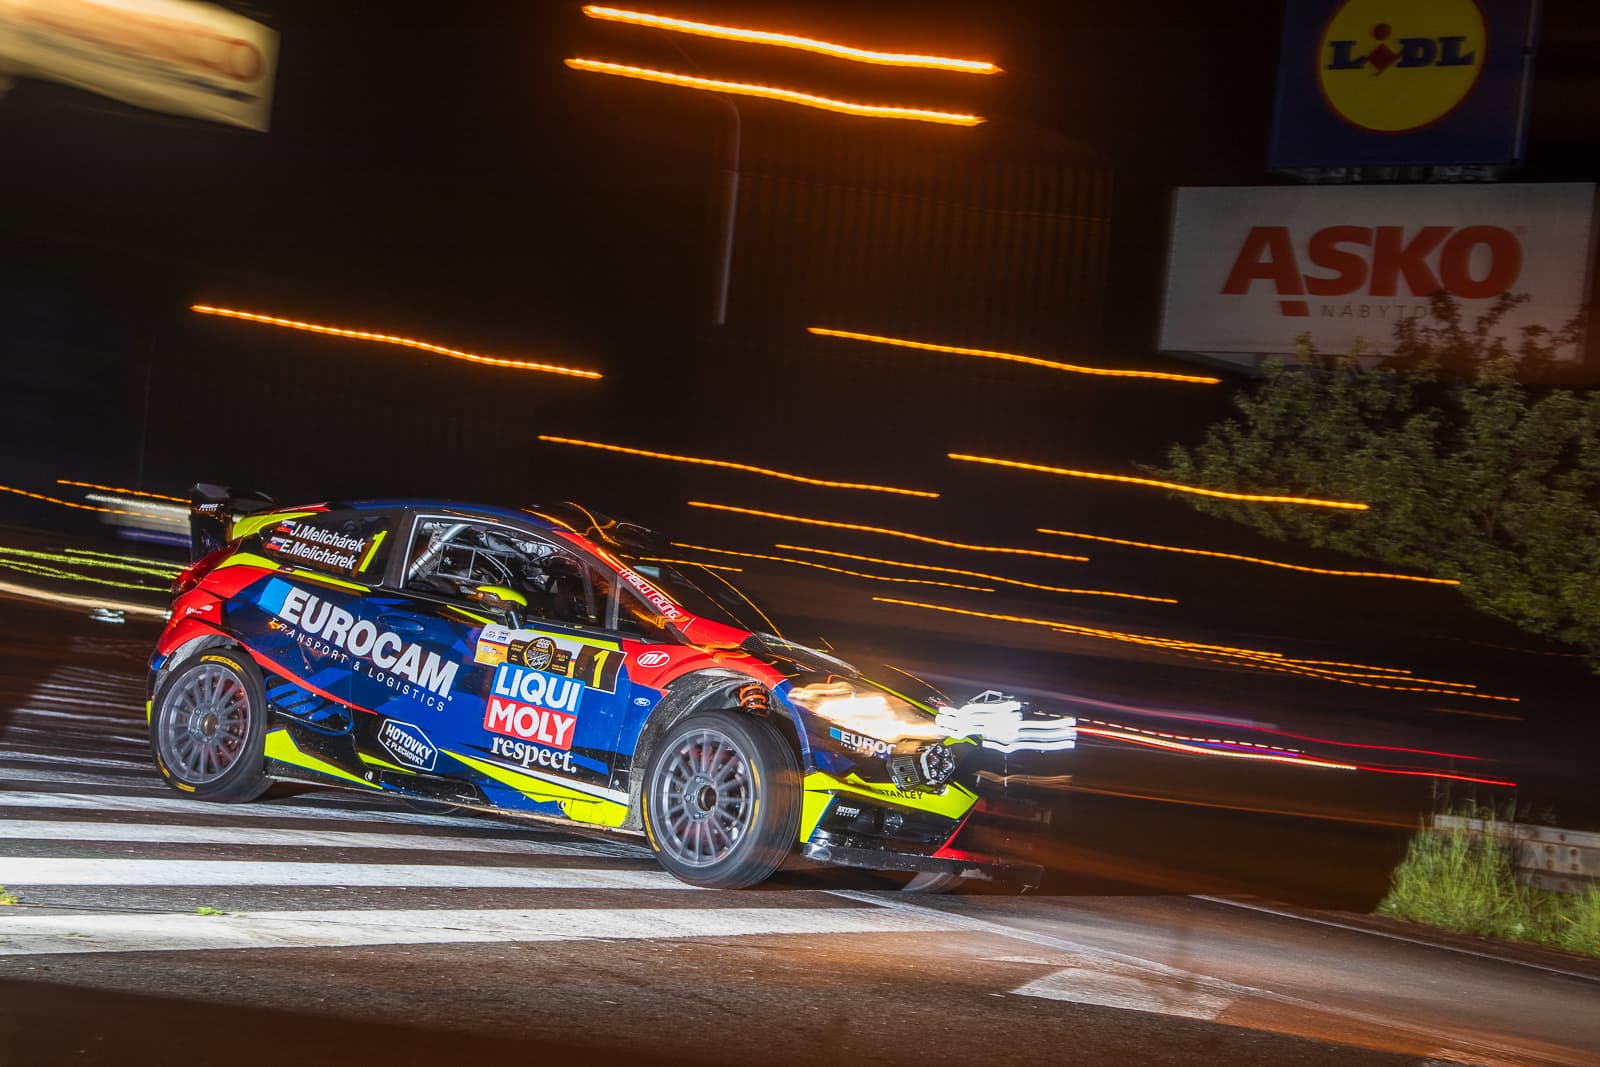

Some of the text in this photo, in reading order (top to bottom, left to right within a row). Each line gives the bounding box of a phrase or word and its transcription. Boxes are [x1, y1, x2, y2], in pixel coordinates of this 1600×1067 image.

[1220, 225, 1523, 300] ASKO
[279, 540, 358, 570] E.Melichárek
[290, 523, 366, 553] J.Melichárek
[358, 530, 388, 573] 1
[270, 617, 347, 664] TRANSPORT
[353, 661, 360, 671] &
[368, 669, 445, 712] LOGISTICS
[592, 649, 610, 689] 1
[495, 665, 581, 712] LIQUI
[385, 723, 433, 760] HOTOVKY
[487, 699, 575, 746] MOLY
[386, 738, 425, 766] Z PLECHOVKY
[490, 736, 577, 773] respect.
